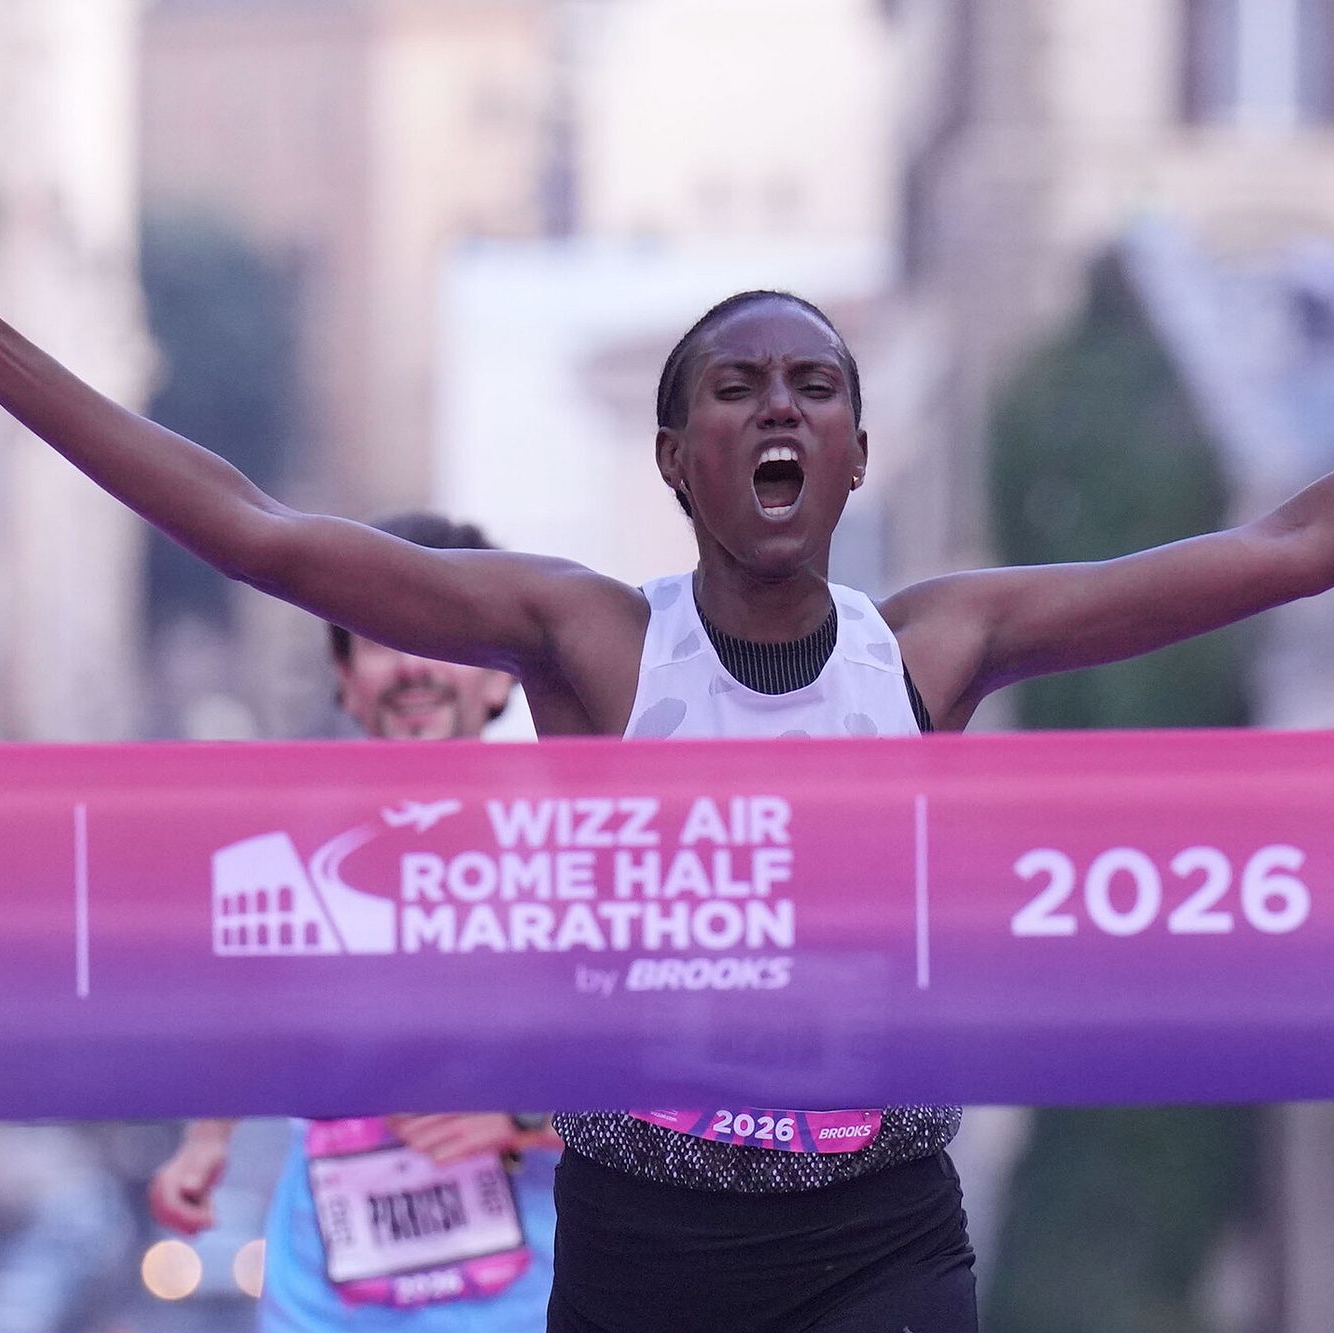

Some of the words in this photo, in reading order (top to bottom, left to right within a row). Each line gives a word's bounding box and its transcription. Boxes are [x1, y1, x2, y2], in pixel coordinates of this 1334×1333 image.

[485, 797, 660, 848] WIZZ
[679, 794, 792, 846] AIR
[400, 851, 597, 901] ROME
[613, 847, 794, 897] HALF
[1010, 843, 1312, 937] 2026
[400, 899, 795, 954] MARATHON
[574, 962, 619, 998] by
[624, 956, 793, 993] BROOKS
[712, 1109, 795, 1142] 2026
[818, 1123, 873, 1141] BROOKS
